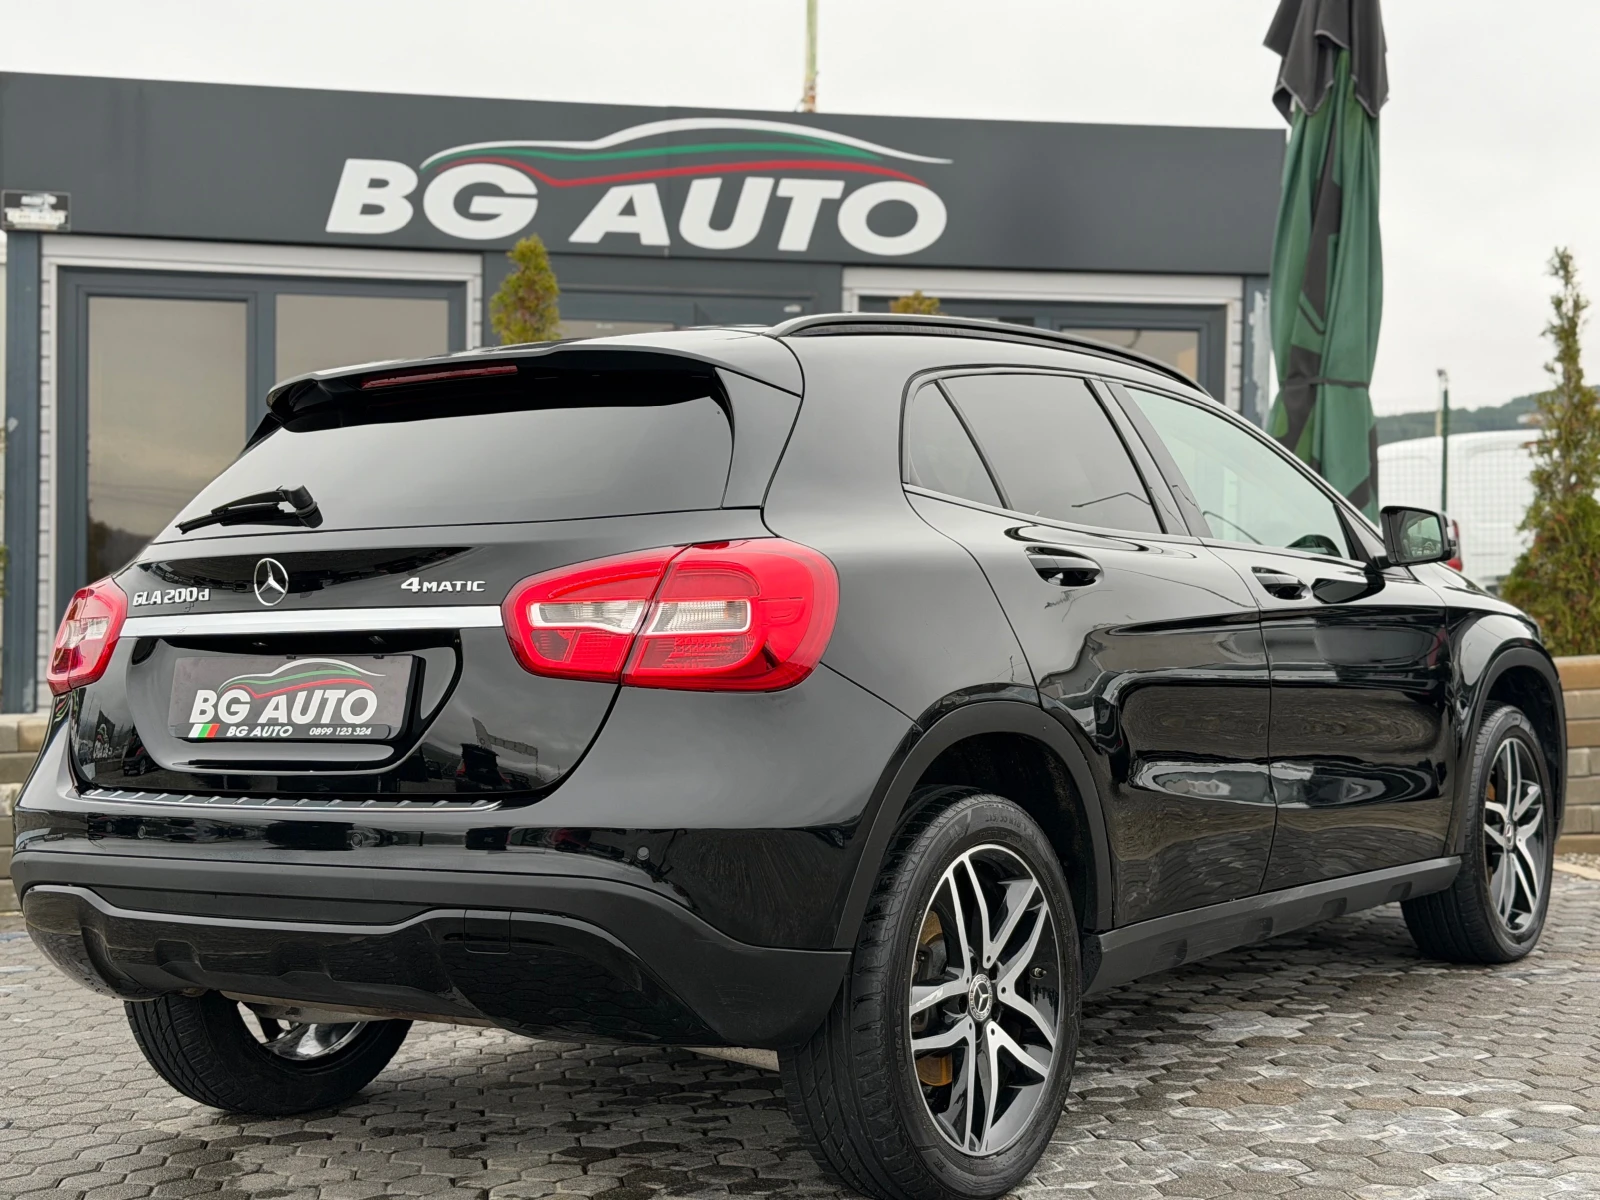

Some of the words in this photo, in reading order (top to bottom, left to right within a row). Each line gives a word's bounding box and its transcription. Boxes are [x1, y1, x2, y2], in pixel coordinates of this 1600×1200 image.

[325, 158, 538, 240] BG
[568, 176, 948, 256] AUTO
[401, 577, 486, 592] 4MATIC
[189, 689, 251, 724] BG
[257, 689, 378, 724] AUTO
[226, 725, 249, 737] BG
[250, 725, 293, 737] AUTO
[309, 727, 333, 736] 0899
[335, 727, 352, 736] 123
[353, 727, 372, 736] 324
